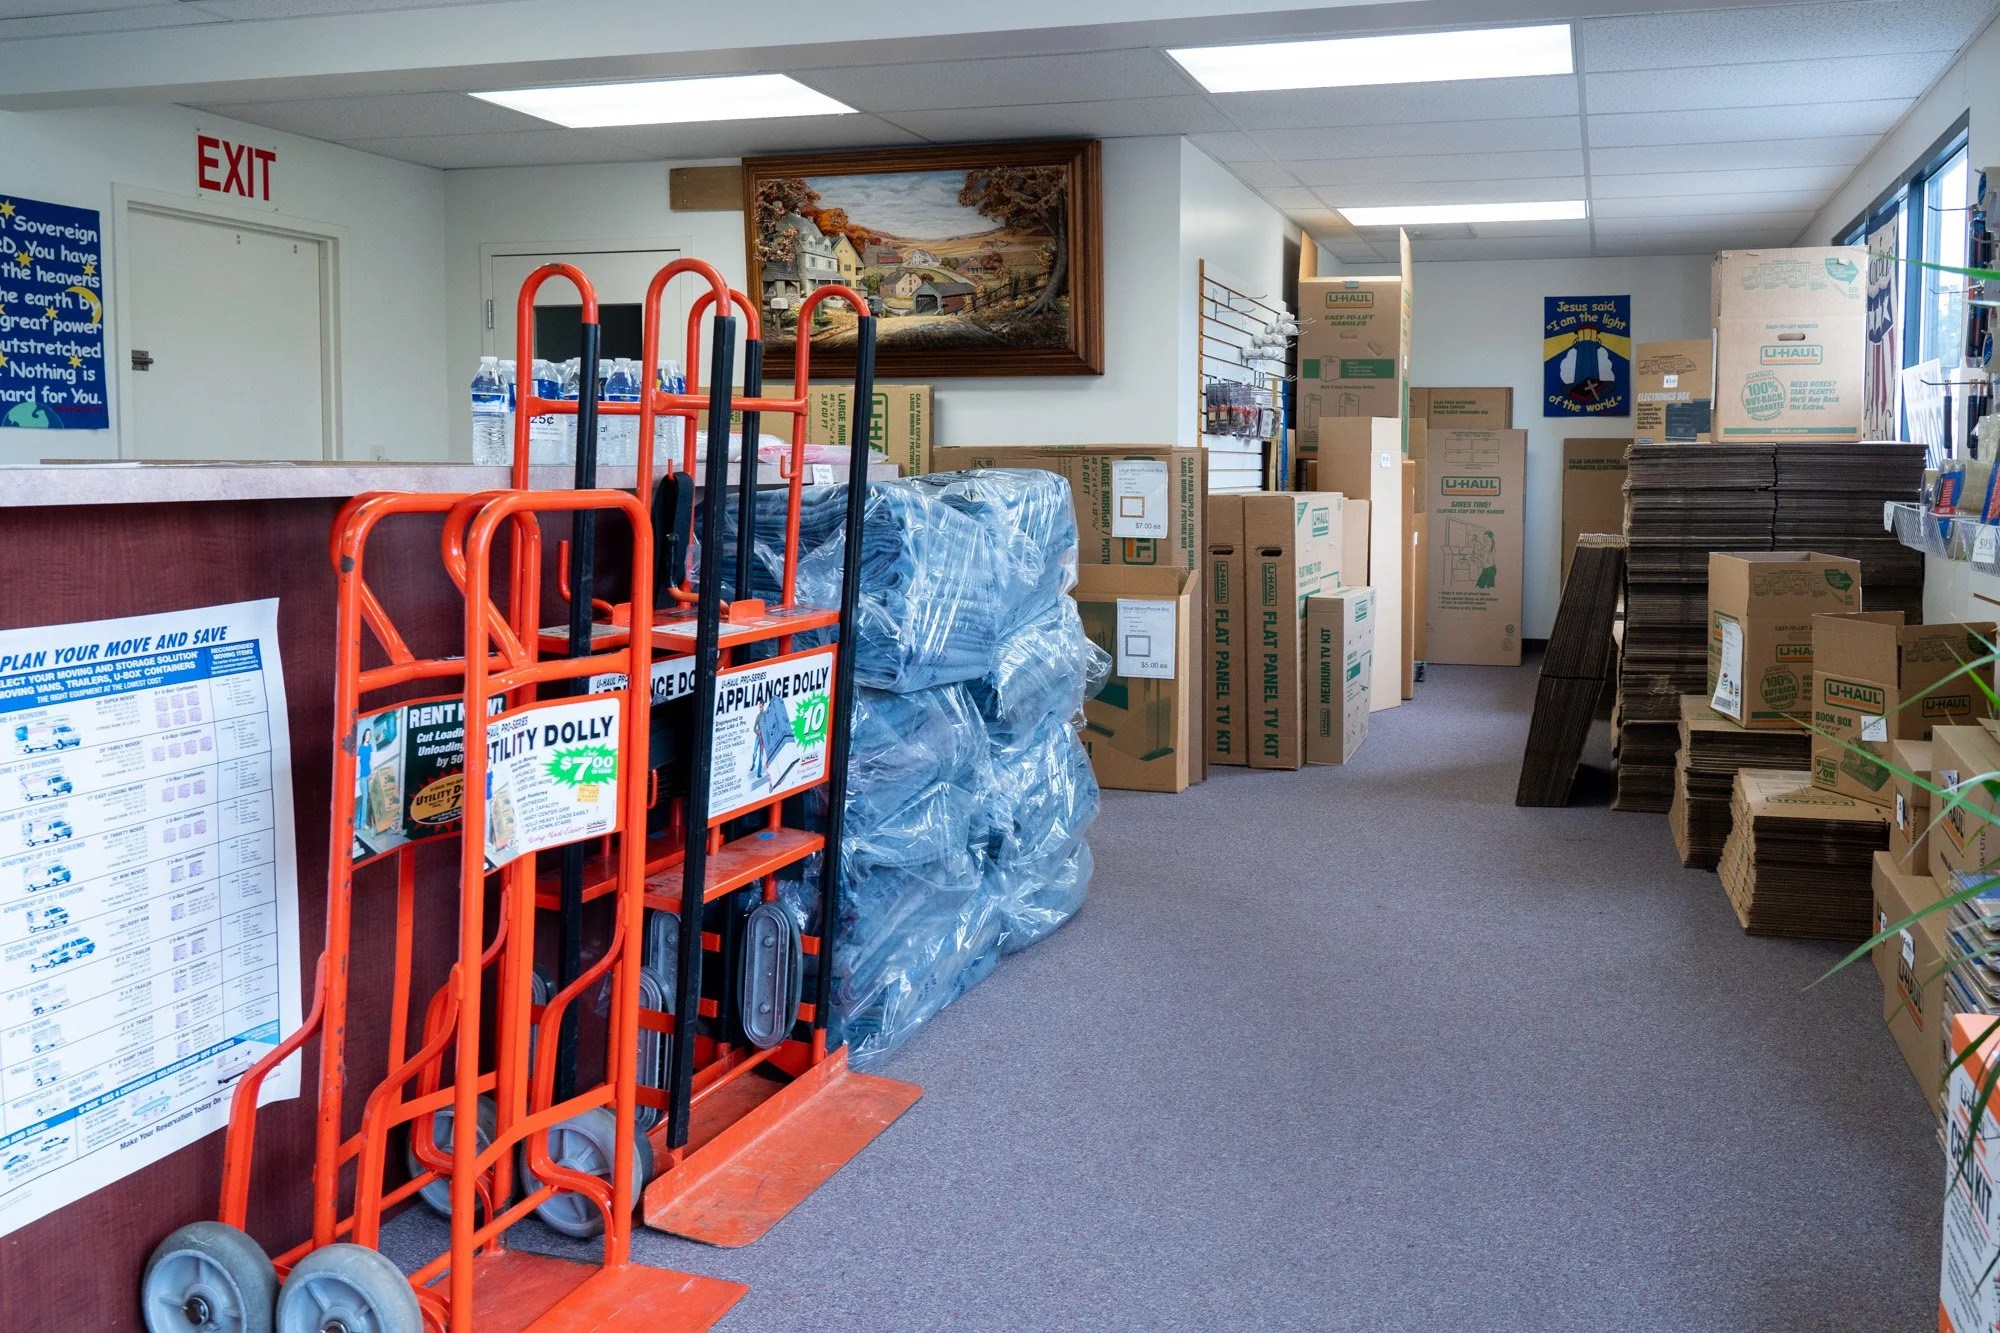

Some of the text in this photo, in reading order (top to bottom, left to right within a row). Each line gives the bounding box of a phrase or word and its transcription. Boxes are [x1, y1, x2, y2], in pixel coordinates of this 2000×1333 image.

[197, 134, 276, 201] EXIT
[14, 215, 98, 245] Sovereign
[25, 241, 98, 266] You have
[1, 265, 100, 288] the heavens
[25, 291, 73, 309] earth
[1328, 294, 1371, 303] U-HAUL
[1557, 300, 1617, 313] Jesus said,
[1, 314, 102, 336] great power
[1560, 311, 1627, 330] am the light
[0, 340, 101, 358] utstretched
[1764, 348, 1818, 358] U-HAUL
[10, 361, 96, 385] Nothing is
[41, 387, 68, 404] for
[70, 388, 102, 405] You.
[1638, 391, 1690, 402] ELECTRONICS BOX
[1748, 381, 1778, 396] 100%
[838, 393, 846, 421] LARGE
[1549, 395, 1563, 405] of
[1562, 398, 1581, 412] the
[1746, 393, 1783, 406] BUY-BACK
[1747, 402, 1785, 414] GUARANTEE
[1805, 396, 1819, 404] Buy
[821, 407, 828, 418] CU
[821, 419, 828, 429] FT
[1082, 456, 1090, 495] 3.9 CU FT
[1101, 456, 1110, 487] LARGE
[1445, 479, 1497, 489] U-HAUL
[1135, 522, 1153, 530] $7.00
[1101, 538, 1110, 565] PICTU
[1267, 565, 1275, 603] U-HAUL
[0, 625, 228, 673] PLAN YOUR MOVE AND SAVE
[210, 643, 255, 654] RECOMMENDED
[213, 649, 254, 661] MOVING ITEMS
[28, 652, 198, 684] YOUR MOVING AND STORAGE SOLUTION
[1141, 661, 1158, 669] $5.00
[1320, 627, 1331, 704] MEDIUM TV KIT
[36, 661, 196, 694] VANS, TRAILERS, U-BOX CONTAINERS
[720, 671, 767, 690] U-HAUL PRO-SERIES
[1215, 609, 1230, 755] FLAT PANEL TV KIT
[1263, 611, 1278, 759] FLAT PANEL TV KIT
[1765, 674, 1793, 688] 100%
[37, 677, 164, 704] THE RIGHT EQUIPMENT AT THE LOWEST COST
[715, 675, 791, 717] APPLIANCE
[792, 666, 829, 696] DOLLY
[1828, 683, 1881, 705] U-HAUL
[1925, 699, 1968, 710] U-HAUL
[409, 704, 456, 729] RENT
[501, 716, 528, 731] PRO-SERIES
[797, 702, 826, 736] $10
[1815, 711, 1853, 728] BOOK BOX
[416, 730, 433, 744] Cut
[544, 715, 614, 748] DOLLY
[436, 753, 465, 768] by 50
[1822, 769, 1836, 779] OK
[416, 789, 451, 807] UTILITY
[120, 1097, 222, 1151] Make Your Reservation Today On
[1974, 1158, 1992, 1226] KIT
